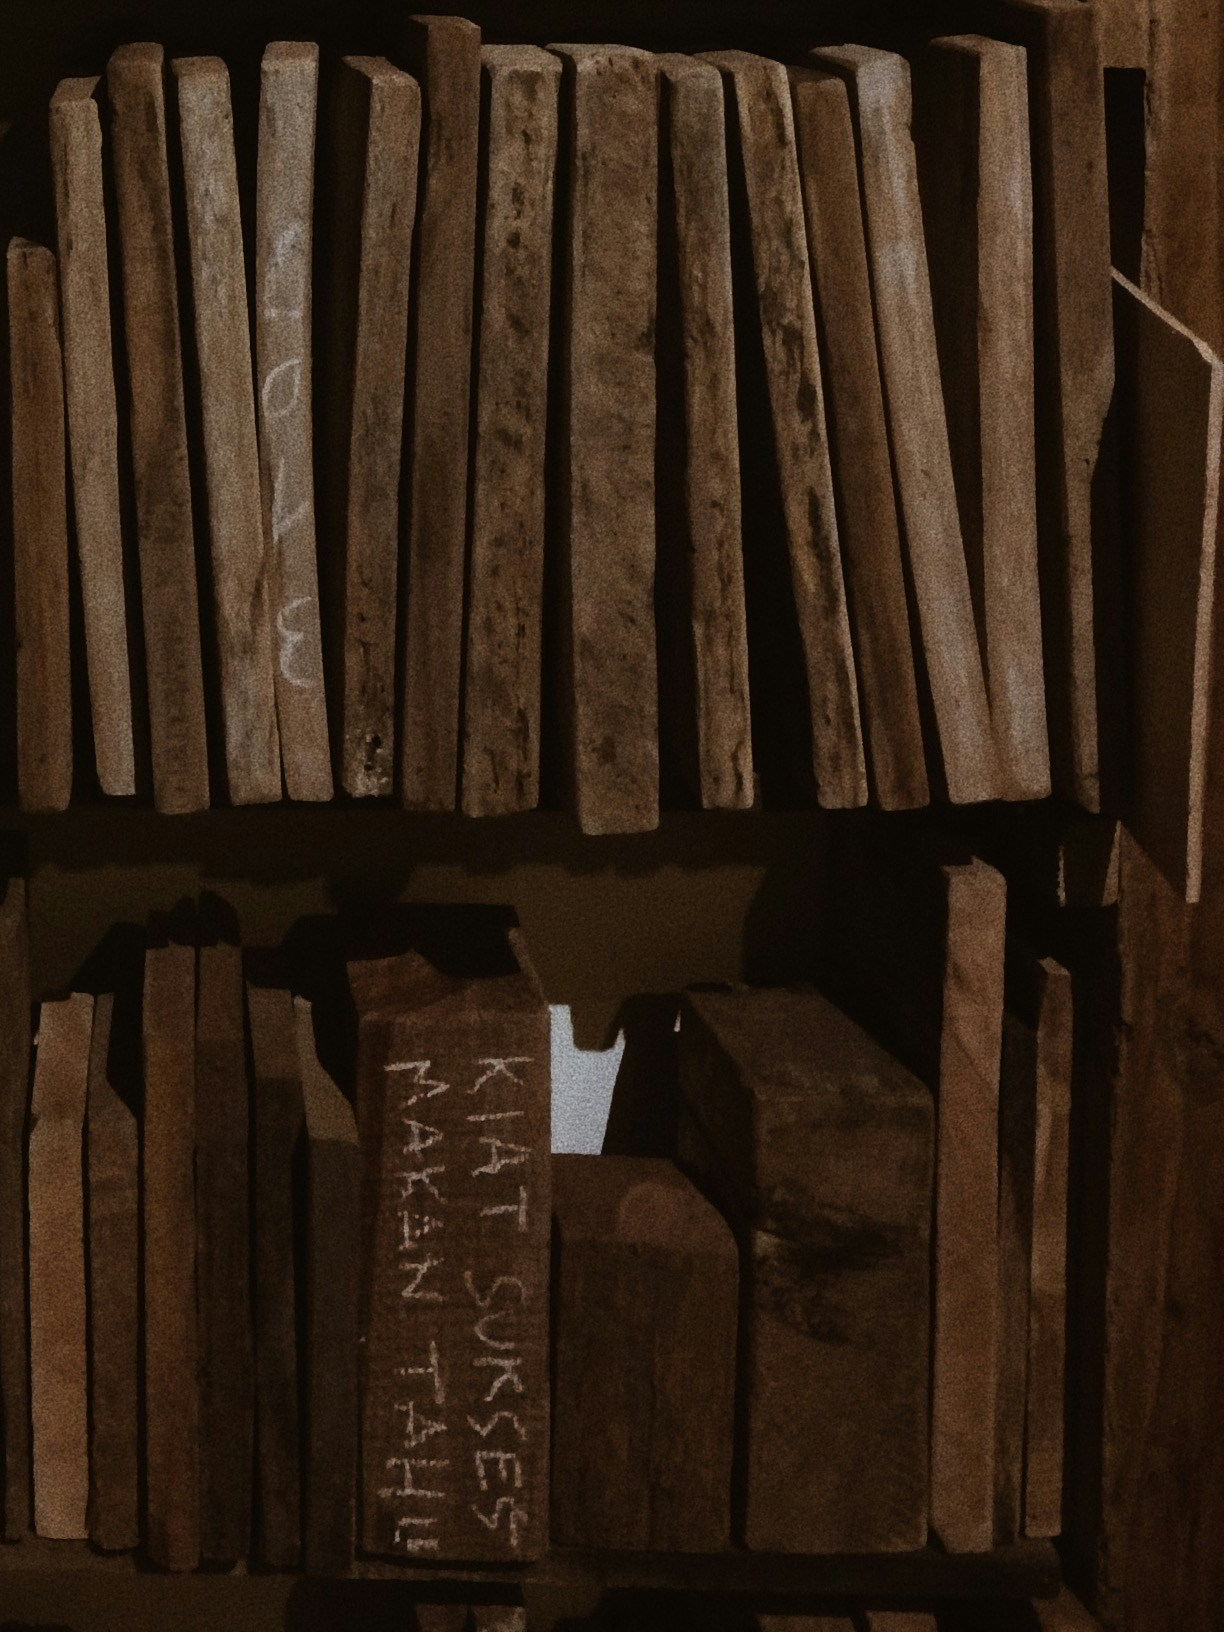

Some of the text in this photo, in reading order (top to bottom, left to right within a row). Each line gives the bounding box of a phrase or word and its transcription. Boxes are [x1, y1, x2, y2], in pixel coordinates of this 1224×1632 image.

[376, 1058, 452, 1554] MAKAN TAHU
[463, 1055, 534, 1551] KIAT SUKSES
